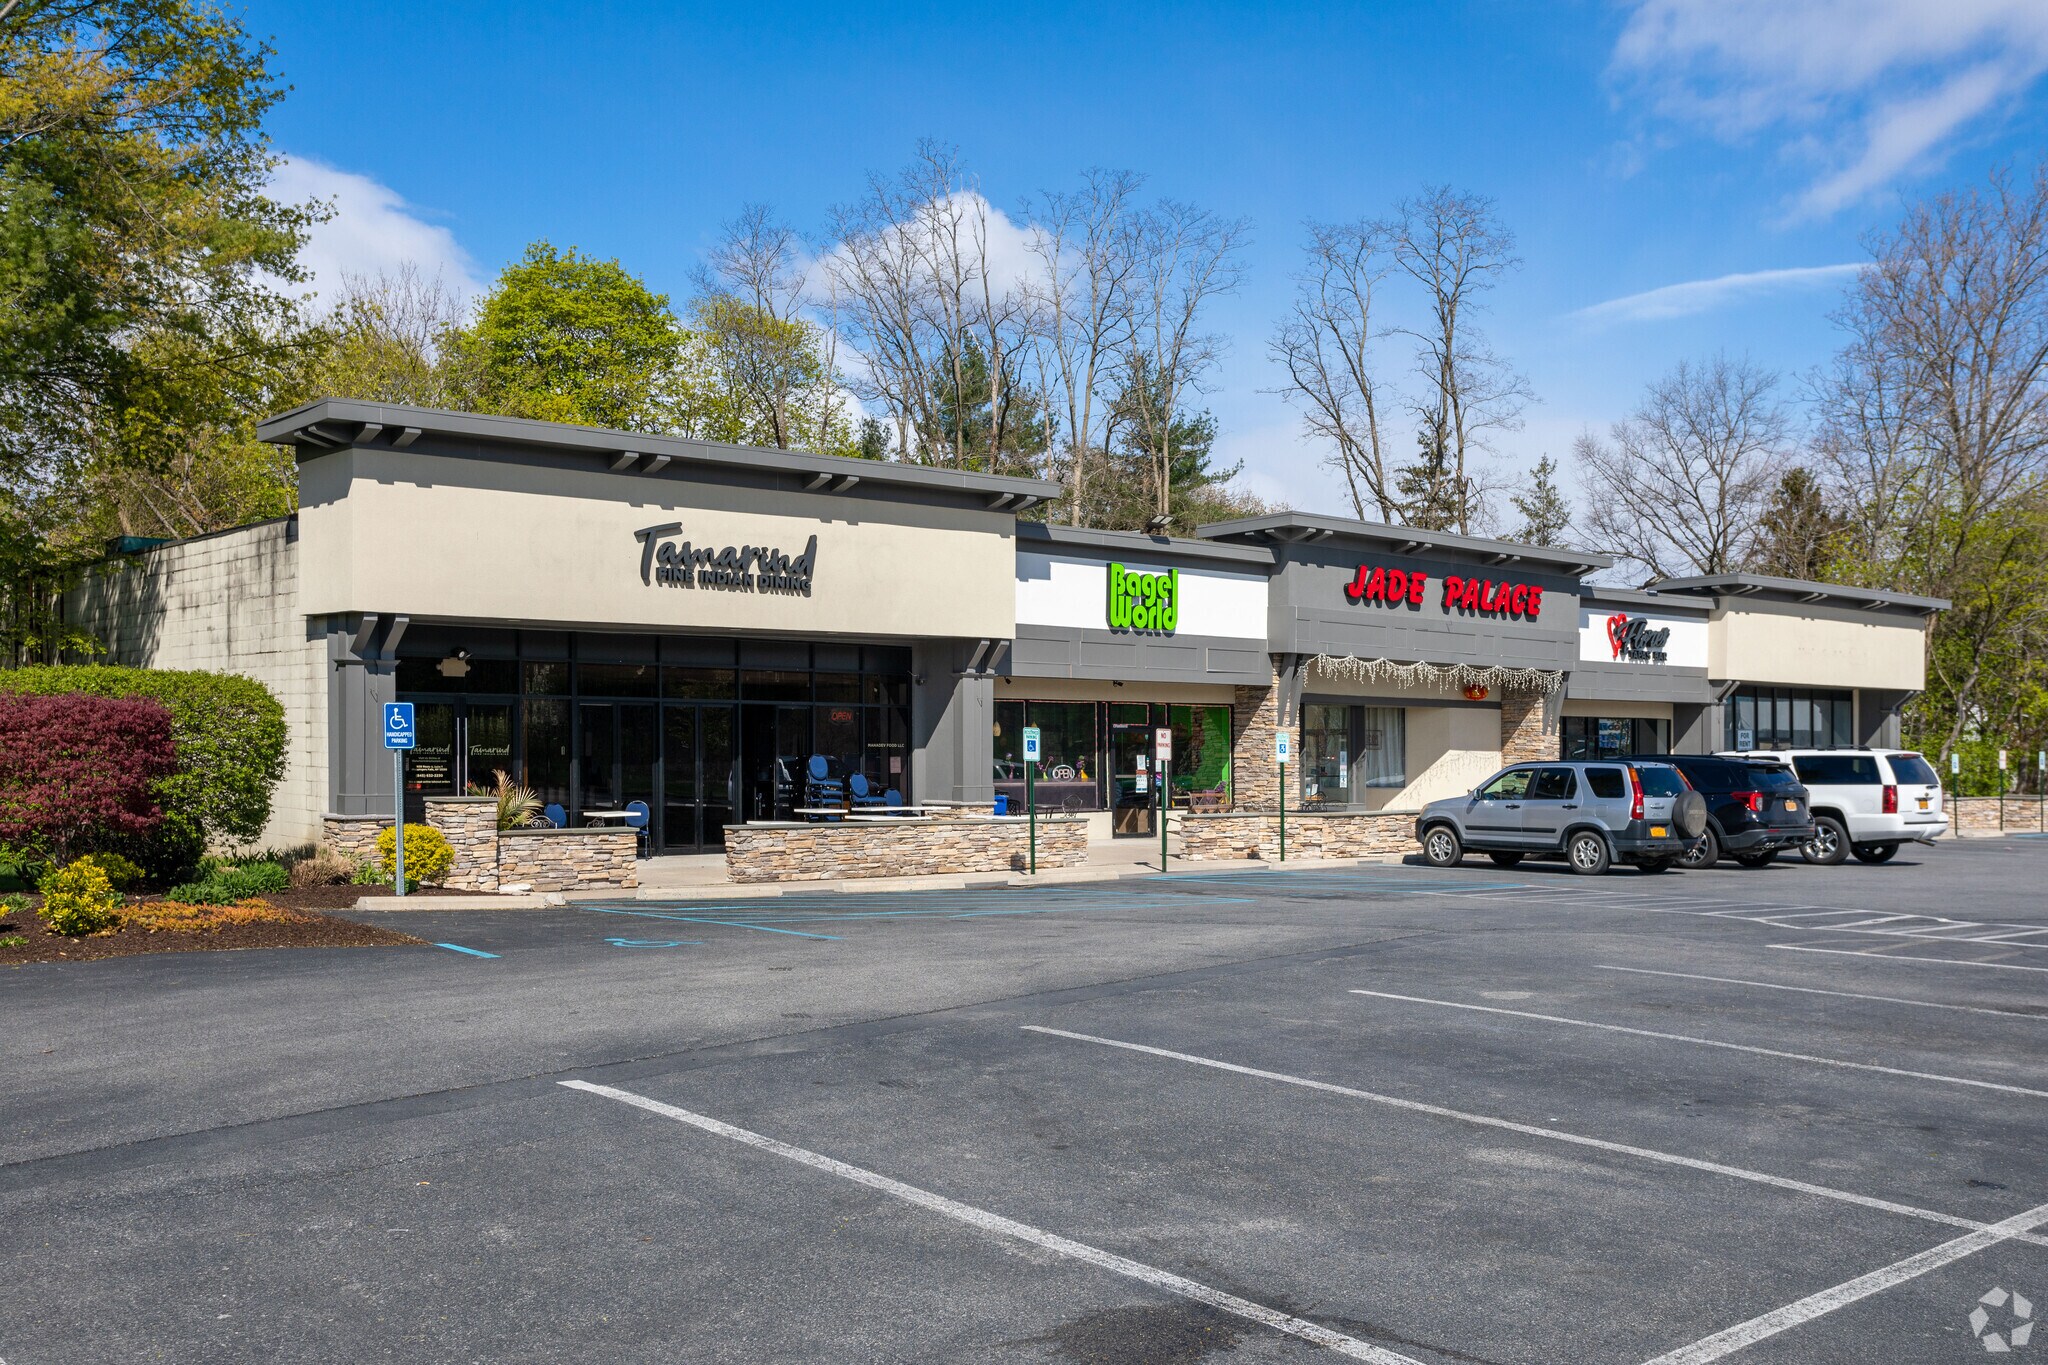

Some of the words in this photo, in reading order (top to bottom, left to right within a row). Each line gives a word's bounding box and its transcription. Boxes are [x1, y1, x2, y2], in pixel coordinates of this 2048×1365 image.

[634, 522, 817, 586] Tamarind
[656, 567, 694, 584] FINE
[698, 570, 755, 588] INDIAN
[757, 575, 812, 592] DINING
[1110, 562, 1178, 607] Bagel
[1346, 565, 1428, 604] JADE
[1443, 576, 1543, 616] PALACE
[1110, 595, 1178, 630] World
[831, 711, 853, 721] OPEN
[469, 744, 510, 756] Tamarind
[1053, 768, 1074, 779] OPEN
